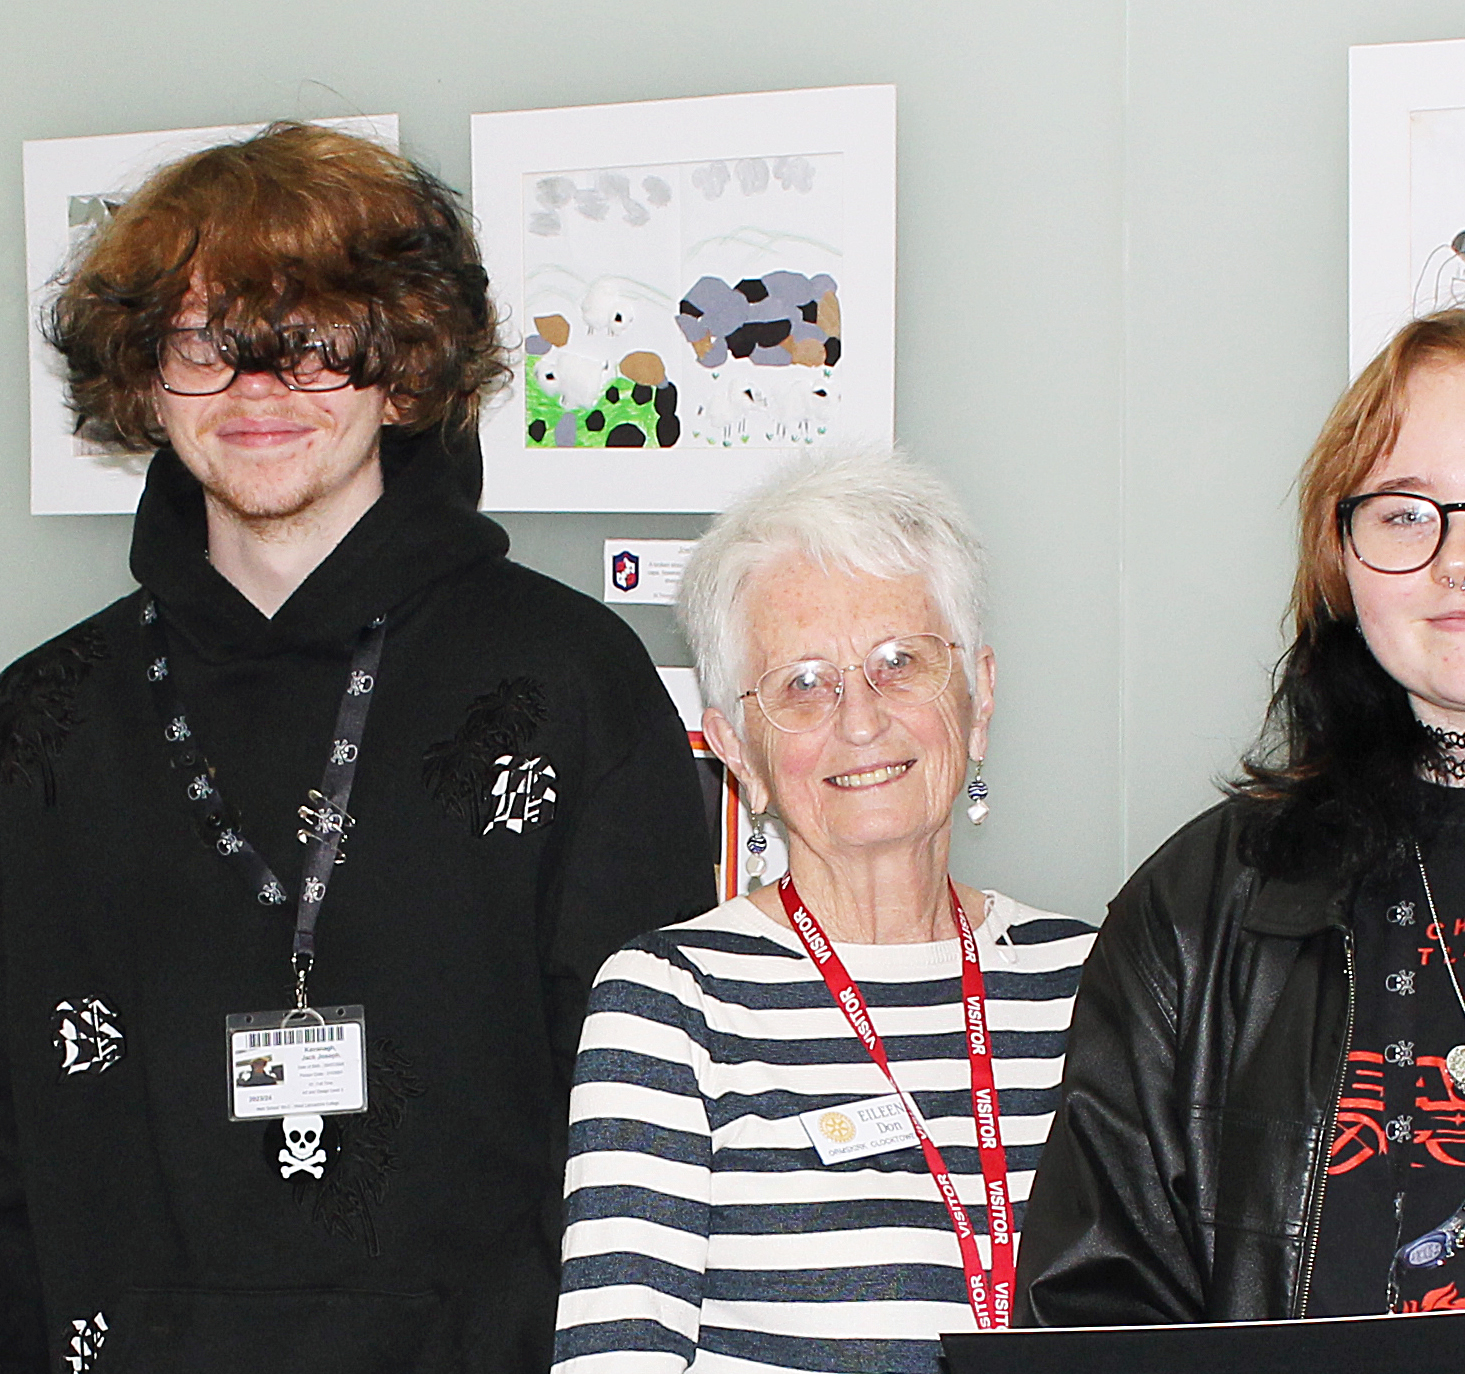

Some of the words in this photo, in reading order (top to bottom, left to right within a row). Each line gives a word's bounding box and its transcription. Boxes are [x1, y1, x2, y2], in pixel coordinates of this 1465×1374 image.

[793, 906, 833, 965] VISITOR
[839, 986, 876, 1050] VISITOR
[966, 996, 986, 1055] VISITOR
[857, 1101, 906, 1123] EILEEN
[870, 1133, 915, 1148] CLOCKTOWE
[876, 1121, 903, 1134] Don
[975, 1088, 997, 1149] VISITOR
[937, 1173, 971, 1239] VISITOR
[988, 1180, 1009, 1245] VISITOR
[970, 1274, 991, 1329] SITOR
[994, 1282, 1010, 1331] VISIT
